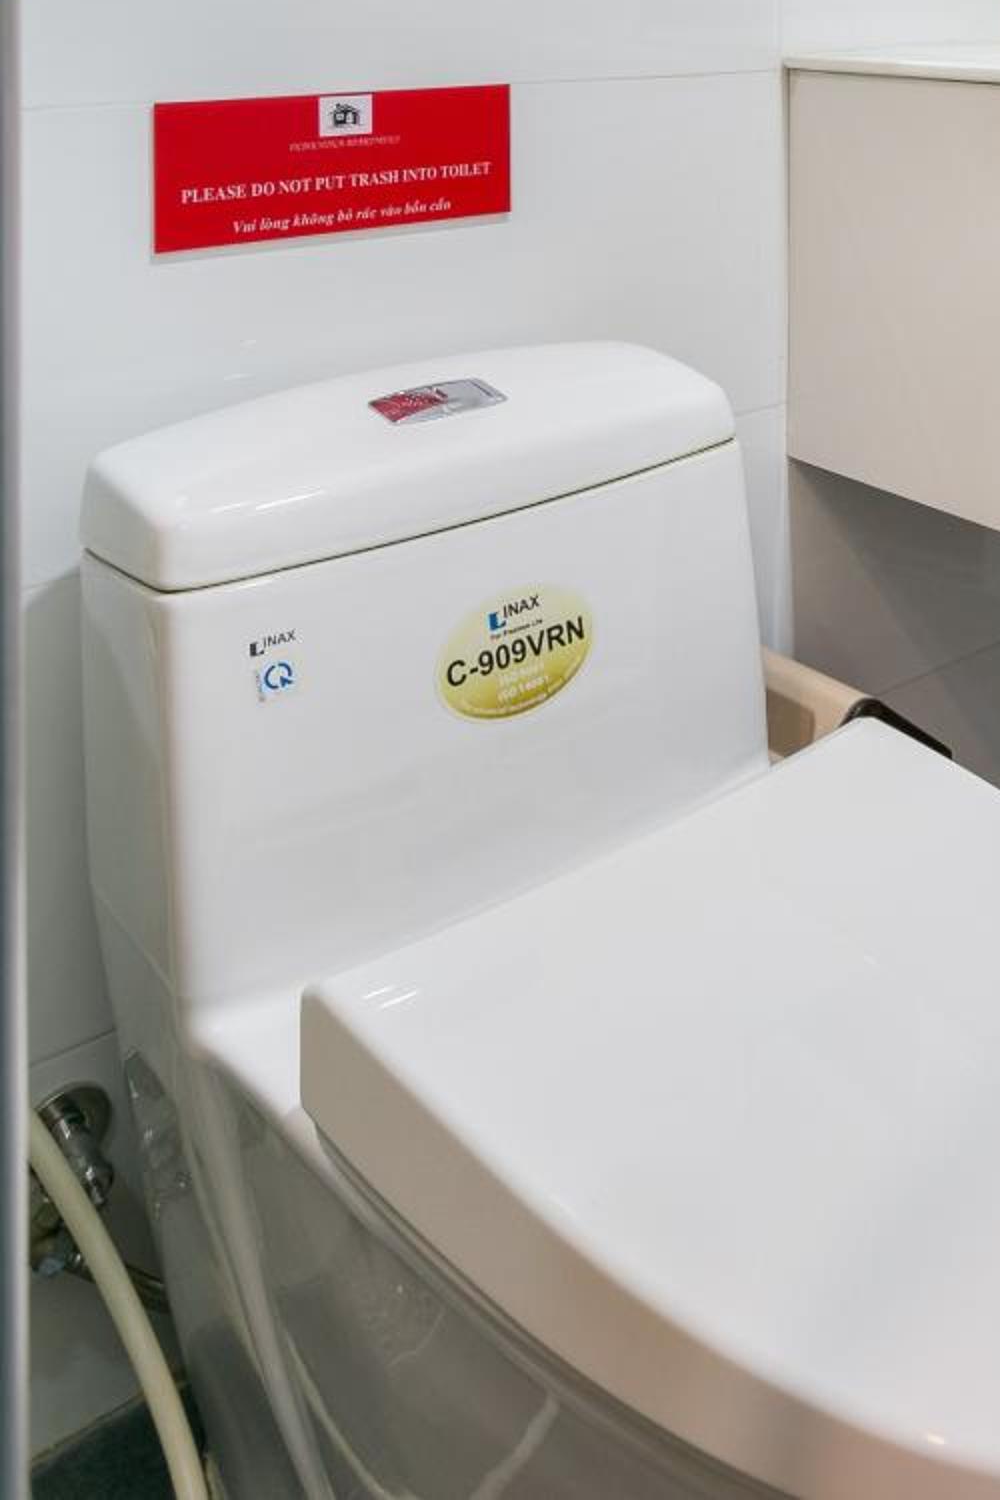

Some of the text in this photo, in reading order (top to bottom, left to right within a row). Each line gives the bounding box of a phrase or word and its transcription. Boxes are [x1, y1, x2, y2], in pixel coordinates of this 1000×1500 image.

[181, 161, 492, 204] PLEASE DO NOT PUT TRASH INTO TOILET
[232, 219, 257, 234] Vui
[259, 217, 289, 231] lòng
[291, 212, 335, 227] không
[503, 594, 541, 619] INAX
[263, 629, 297, 648] INAX
[446, 616, 586, 688] C-909VRN
